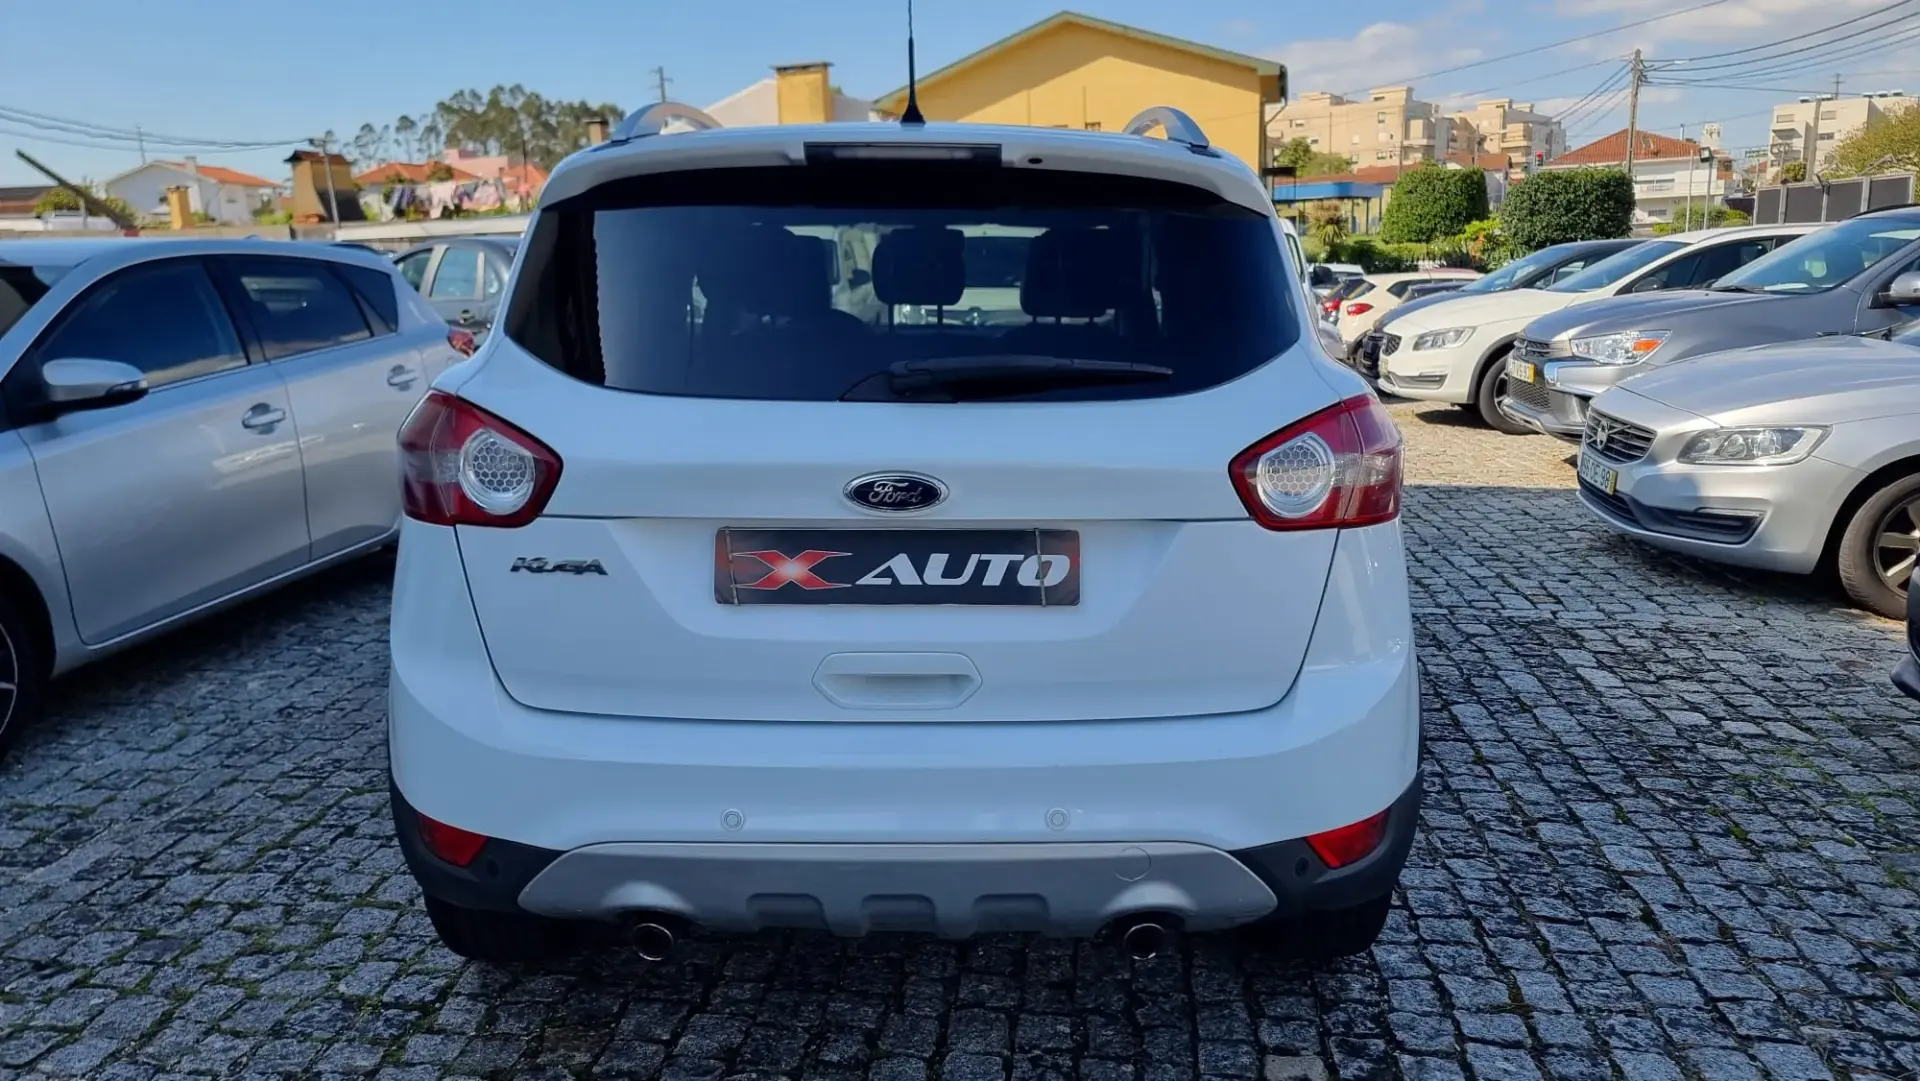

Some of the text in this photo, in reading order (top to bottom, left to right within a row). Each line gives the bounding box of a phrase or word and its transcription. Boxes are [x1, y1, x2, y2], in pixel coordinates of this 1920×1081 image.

[868, 481, 922, 503] Ford
[731, 549, 1070, 590] X AUTO
